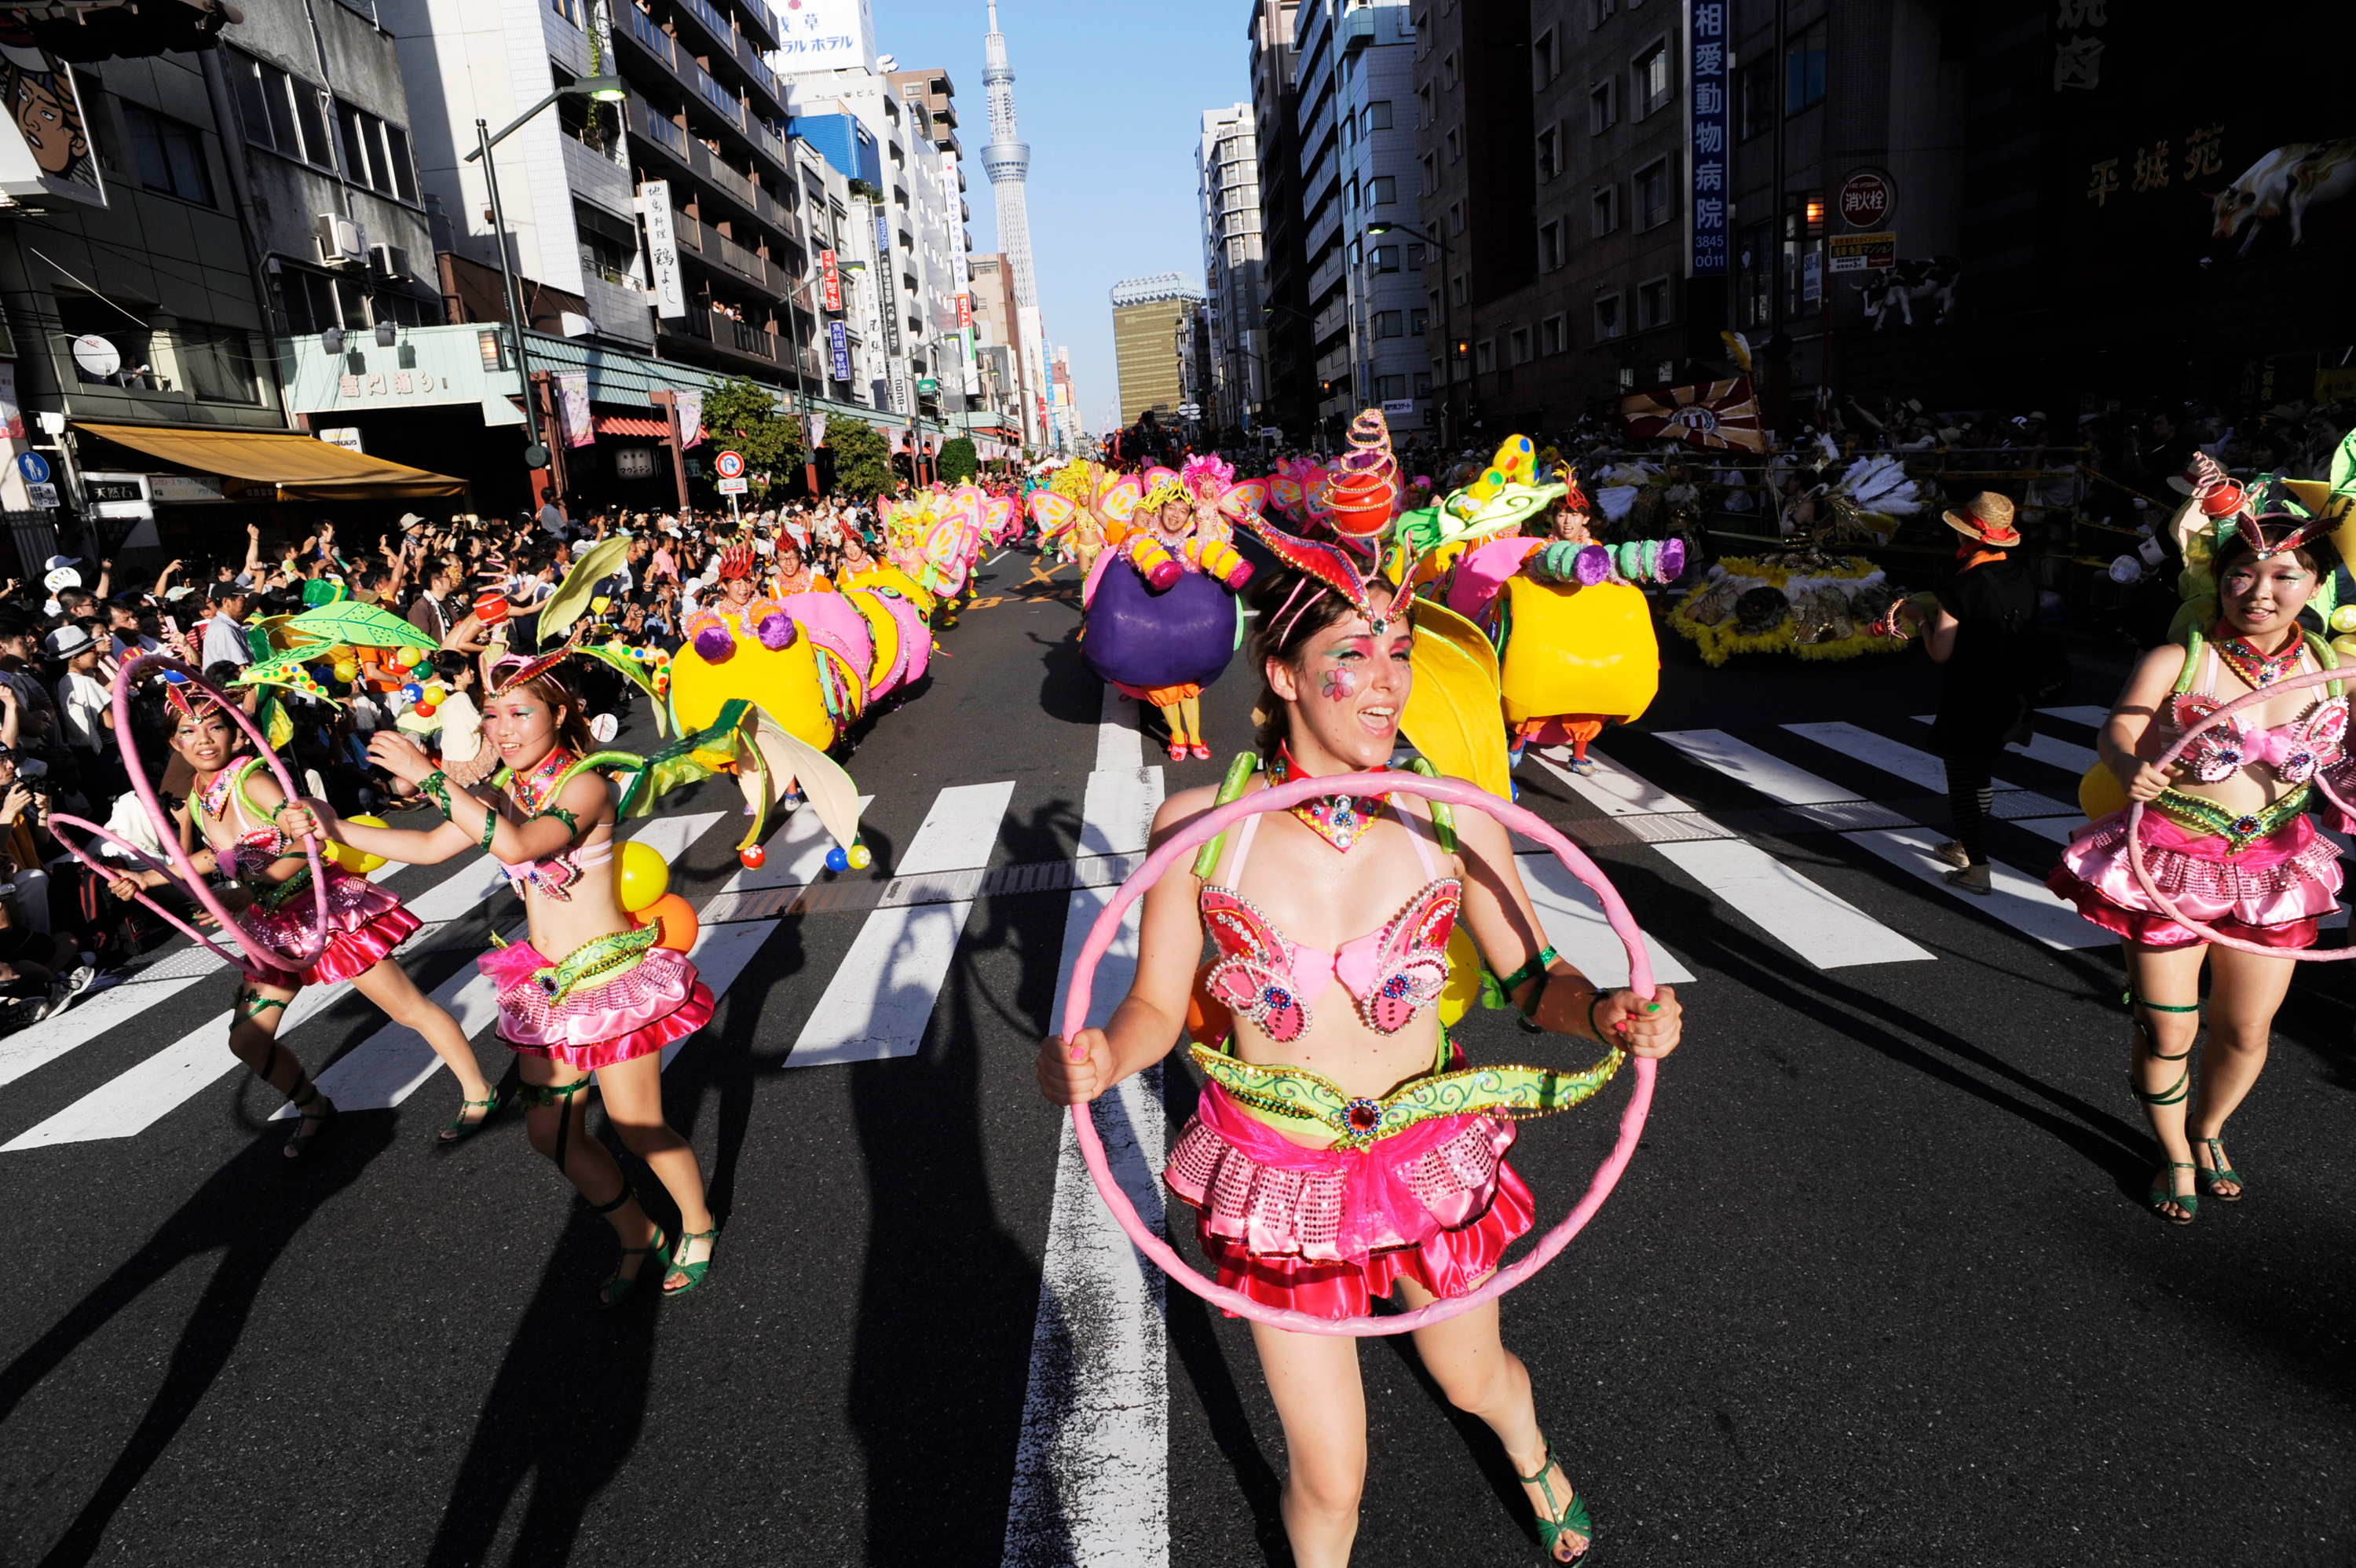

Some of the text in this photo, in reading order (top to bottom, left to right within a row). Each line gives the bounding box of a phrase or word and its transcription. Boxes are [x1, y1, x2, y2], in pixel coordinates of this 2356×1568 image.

[763, 35, 854, 56] ラルホテル
[1695, 3, 1722, 229] 相愛動物病院
[2087, 122, 2225, 207] 平城苑
[1845, 189, 1885, 212] 消火栓
[946, 178, 966, 283] 浅草セントラルホテル
[1696, 236, 1724, 248] 3845
[1696, 255, 1724, 268] 0011
[959, 298, 968, 321] ガスト
[832, 323, 845, 349] 魚料理
[869, 319, 884, 375] 尾張屋
[339, 369, 434, 398] 雷門通り
[94, 486, 134, 500] 天然石
